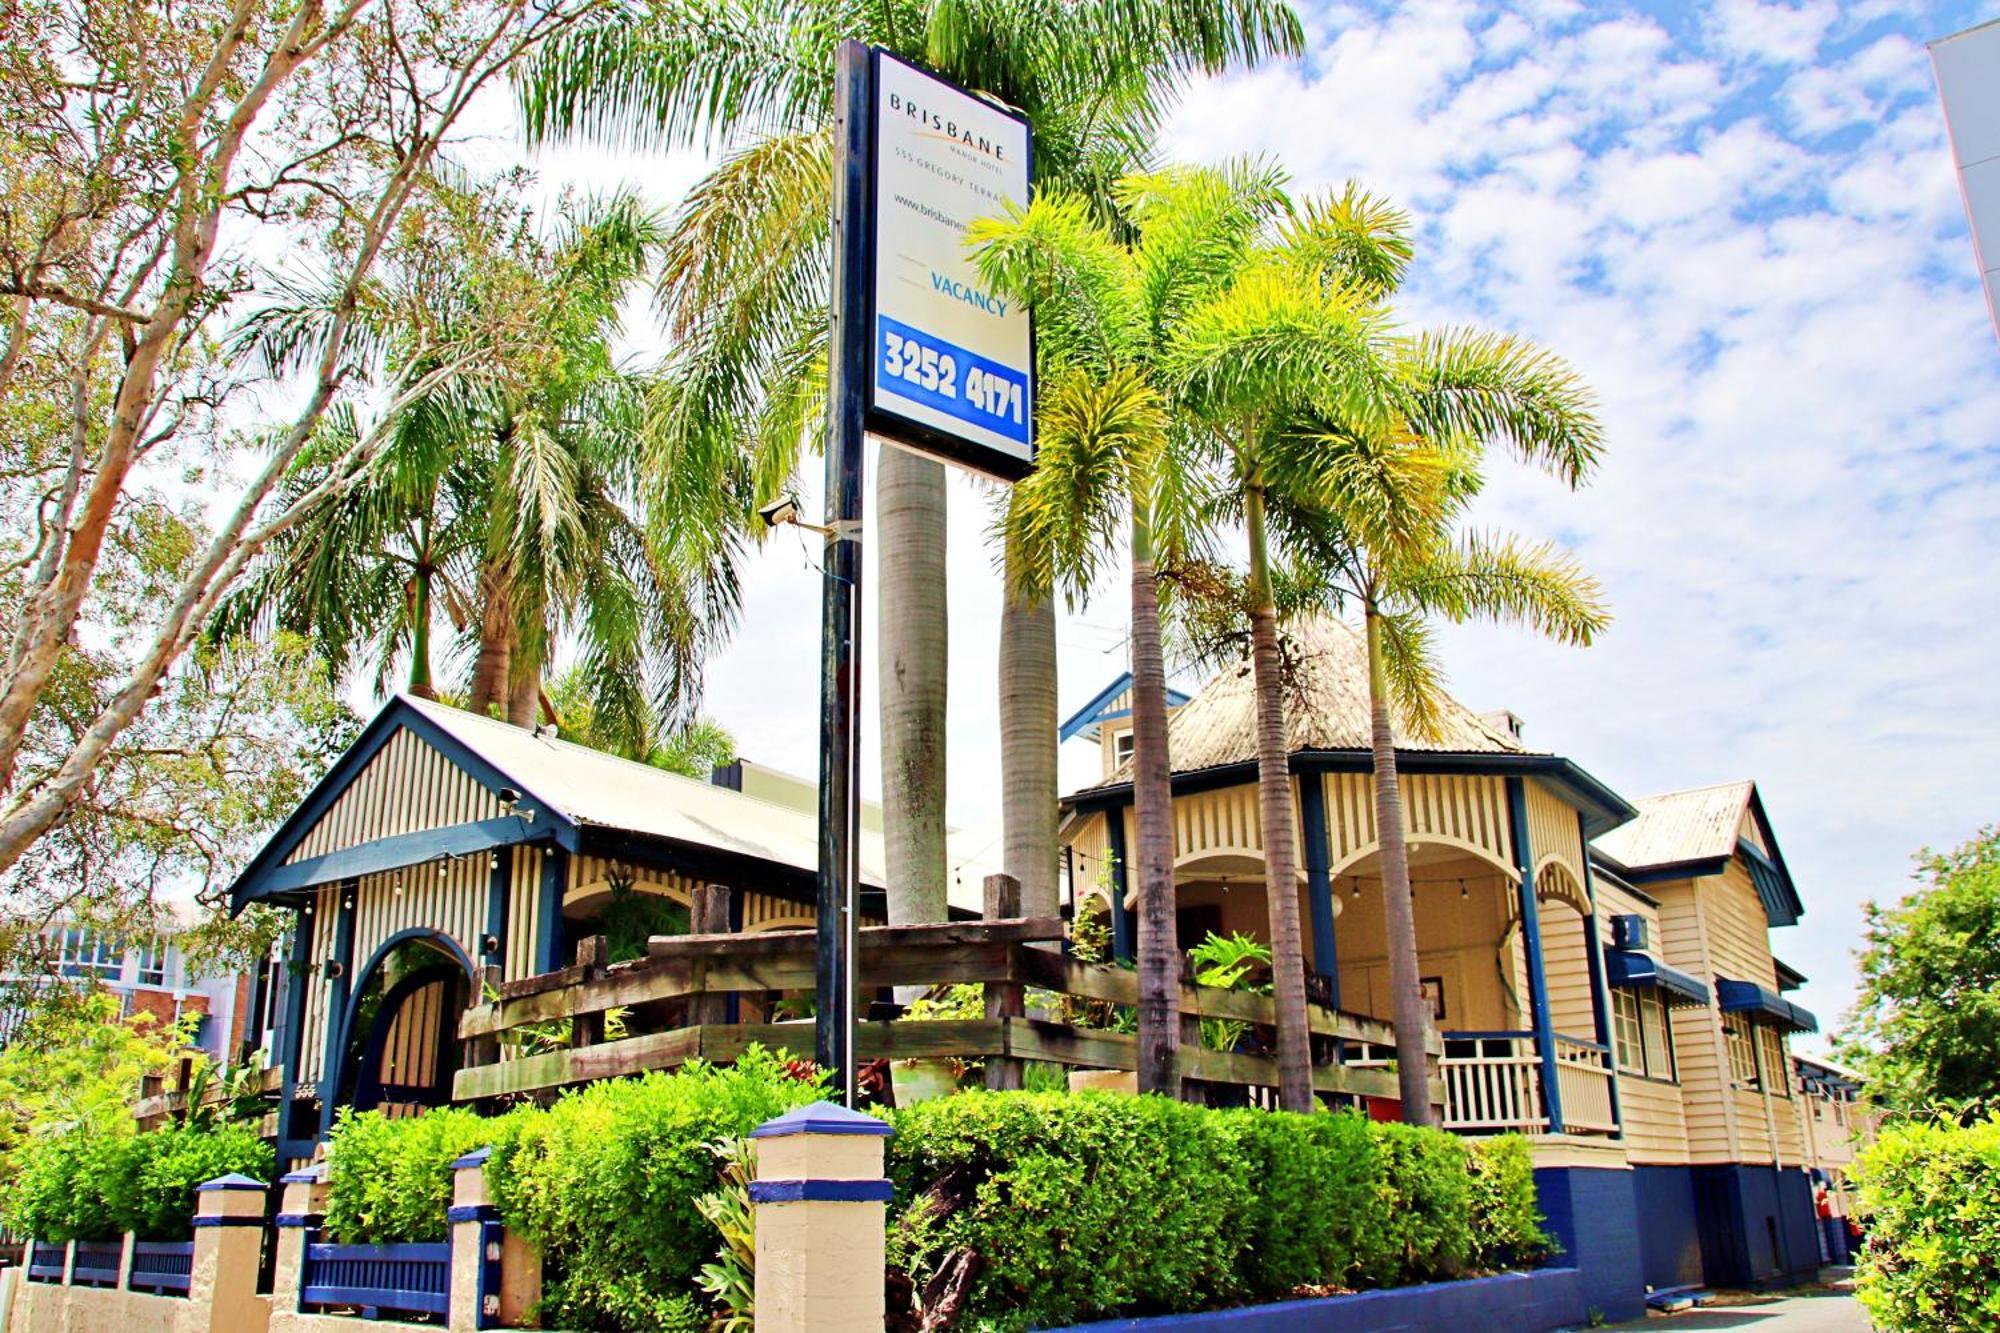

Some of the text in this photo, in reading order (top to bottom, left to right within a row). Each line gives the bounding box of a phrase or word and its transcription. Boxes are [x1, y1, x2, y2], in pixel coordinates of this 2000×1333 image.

[890, 93, 1004, 160] BRISBANE
[895, 147, 913, 162] 555
[916, 158, 964, 185] GREGORY
[931, 271, 1007, 318] VACANCY
[884, 331, 1022, 425] 3252 4171
